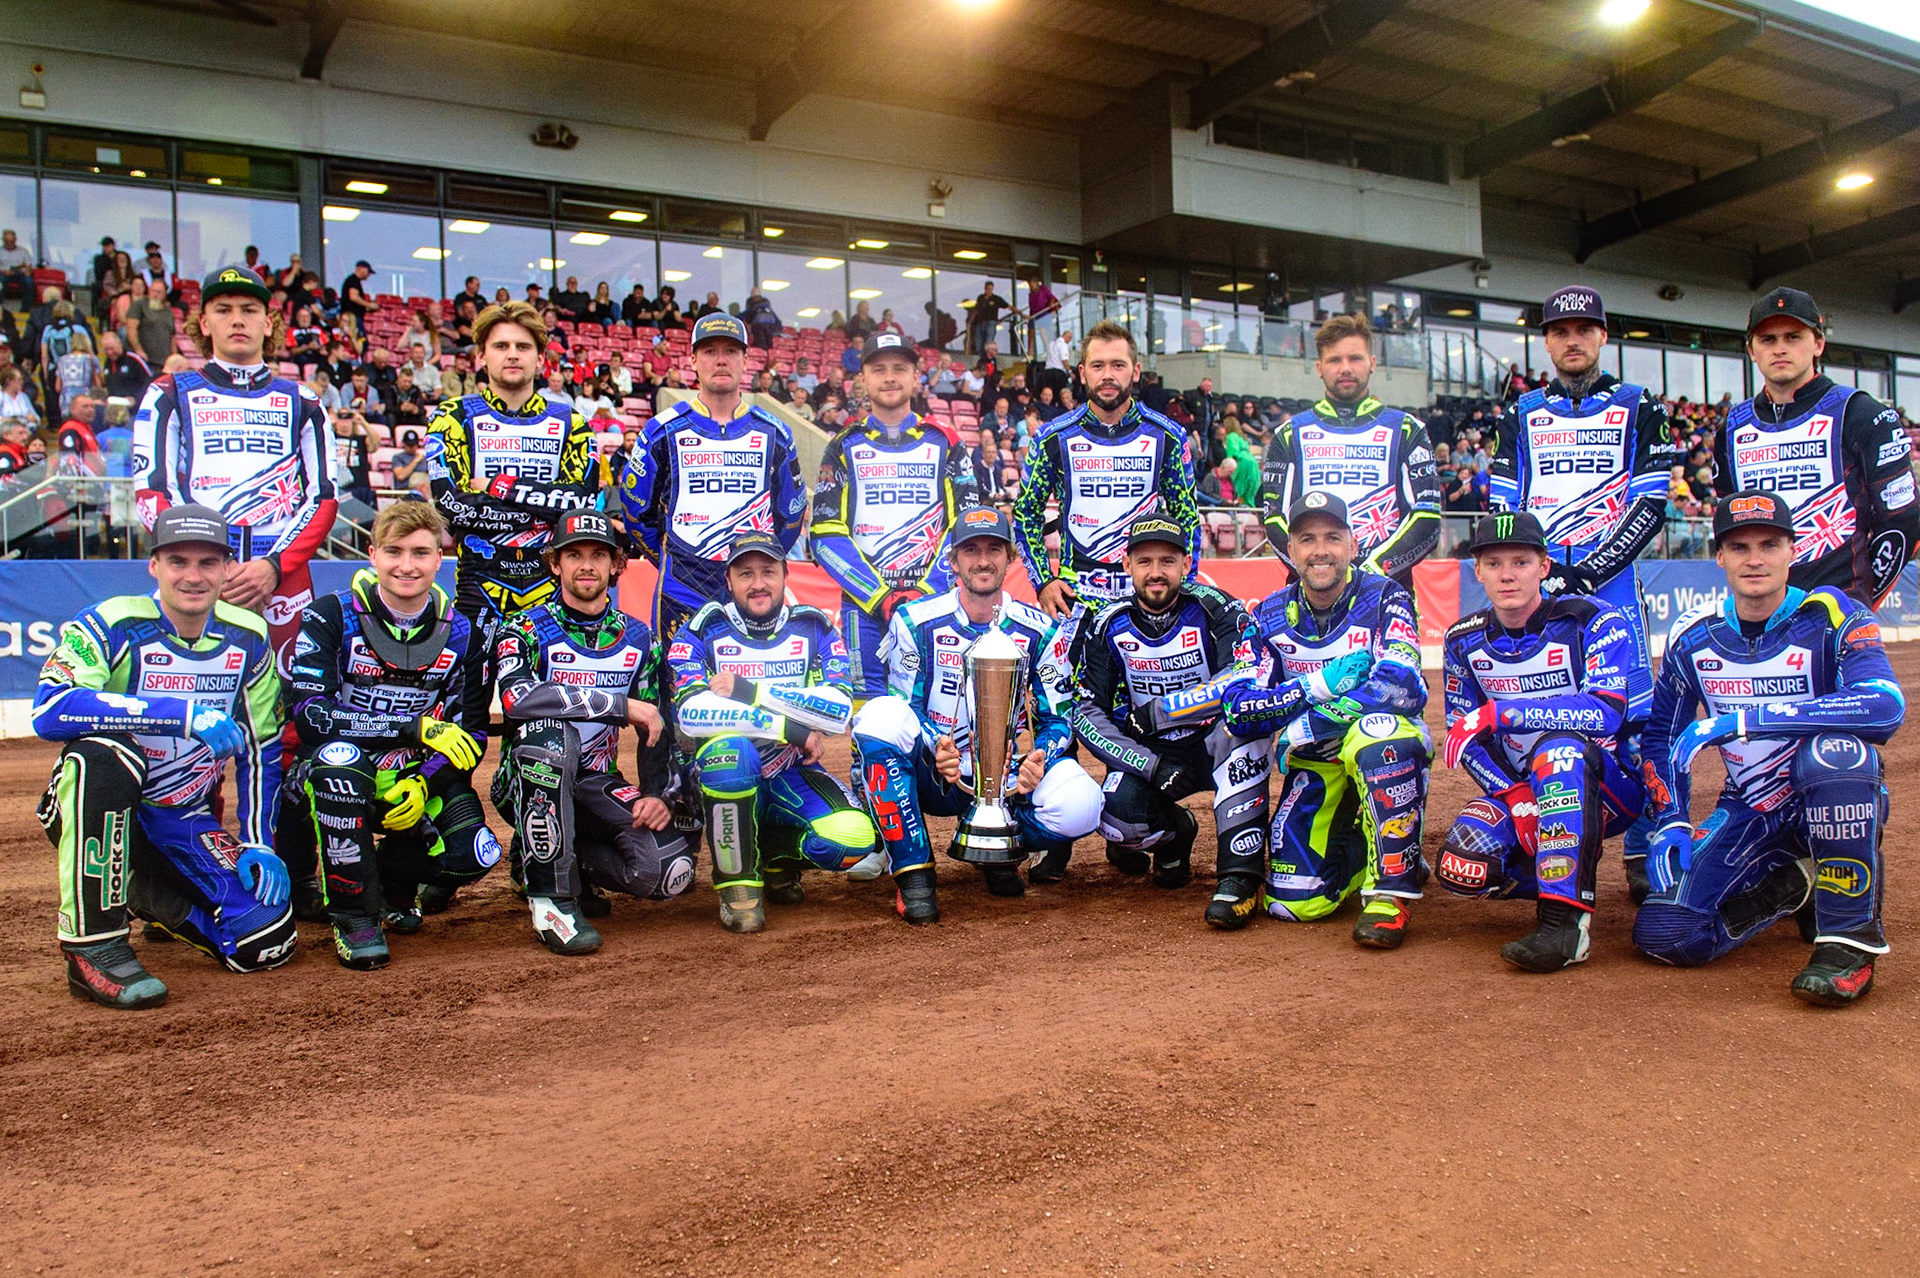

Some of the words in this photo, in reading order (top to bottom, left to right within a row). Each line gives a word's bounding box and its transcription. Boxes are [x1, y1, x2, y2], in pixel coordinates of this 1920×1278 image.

[1553, 293, 1593, 307] ADRIAN
[1559, 301, 1587, 312] FLUX
[270, 396, 288, 407] 18
[197, 410, 244, 424] SPORTS
[245, 411, 287, 426] INSURE
[1535, 417, 1549, 425] SCB
[1605, 411, 1625, 425] 10
[203, 429, 250, 438] BRITISH
[253, 430, 283, 438] FINAL
[547, 423, 560, 435] 2
[1808, 420, 1829, 437] 17
[749, 436, 763, 448] 5
[1372, 431, 1387, 442] 8
[1534, 431, 1575, 446] SPORTS
[1577, 430, 1620, 444] INSURE
[1741, 434, 1755, 443] SCB
[204, 438, 284, 455] 2022
[480, 438, 521, 450] SPORTS
[523, 439, 558, 453] INSURE
[1140, 440, 1150, 453] 7
[1305, 446, 1344, 458] SPORTS
[1346, 446, 1384, 458] INSURE
[684, 452, 723, 465] SPORTS
[724, 452, 762, 466] INSURE
[926, 448, 931, 460] 1
[1538, 450, 1580, 459] BRITISH
[1582, 450, 1615, 458] FINAL
[1739, 447, 1778, 465] SPORTS
[1779, 443, 1824, 459] INSURE
[859, 465, 897, 477] SPORTS
[898, 464, 934, 477] INSURE
[1074, 458, 1113, 470] SPORTS
[1114, 458, 1150, 470] INSURE
[1538, 459, 1614, 476] 2022
[1743, 466, 1784, 478] BRITISH
[1786, 464, 1821, 473] FINAL
[485, 465, 552, 481] 2022
[1309, 472, 1379, 486] 2022
[689, 479, 757, 494] 2022
[1744, 473, 1821, 491] 2022
[865, 490, 931, 505] 2022
[1080, 484, 1144, 498] 2022
[245, 500, 280, 523] BRITISH
[684, 513, 710, 521] BRITISH
[580, 514, 607, 532] FTS
[1567, 517, 1608, 542] BRITISH
[1819, 517, 1850, 538] FINAL
[1586, 506, 1654, 571] HINCHLIFFE
[895, 541, 930, 568] BRITISH
[500, 560, 540, 569] SIMPSONS
[1674, 586, 1728, 615] World
[940, 636, 956, 645] SCB
[1181, 630, 1198, 649] 13
[1348, 631, 1368, 650] 14
[789, 641, 803, 655] 3
[150, 655, 168, 664] SCB
[225, 652, 243, 670] 12
[556, 653, 571, 662] SCB
[623, 652, 638, 667] 9
[1162, 651, 1201, 670] INSURE
[1477, 661, 1490, 669] SCB
[1547, 648, 1564, 667] 6
[1702, 660, 1718, 669] SCB
[1786, 653, 1804, 671] 4
[721, 663, 764, 676] SPORTS
[766, 662, 803, 676] INSURE
[1284, 659, 1321, 673] SPORTS
[147, 674, 195, 691] SPORTS
[197, 674, 237, 691] INSURE
[553, 670, 596, 685] SPORTS
[597, 671, 632, 687] INSURE
[1129, 674, 1169, 682] BRITISH
[1170, 670, 1201, 681] FINAL
[1482, 677, 1520, 692] SPORTS
[1521, 671, 1567, 690] INSURE
[353, 685, 402, 697] BRITISH
[1704, 679, 1751, 695] SPORTS
[1753, 677, 1806, 694] INSURE
[349, 689, 426, 713] 2022
[1240, 689, 1301, 713] STELLAR
[1713, 701, 1761, 711] BRITISH
[59, 714, 100, 723] Grant
[103, 715, 181, 726] Henderson
[1365, 713, 1392, 725] ATPI
[1525, 708, 1604, 721] KRAJEWSKI
[351, 721, 389, 730] Tankers
[1525, 720, 1605, 731] KONSTRUKCJE
[1080, 720, 1122, 757] Warren
[1122, 748, 1148, 771] Ltd
[1821, 739, 1858, 755] ATPI
[724, 755, 738, 763] OIL
[523, 769, 542, 780] ROCK
[543, 775, 558, 785] OIL
[1472, 759, 1510, 788] Henderson
[886, 757, 919, 838] FILTRATION
[1540, 799, 1561, 810] ROCK
[1562, 796, 1579, 807] OIL
[1834, 803, 1874, 822] DOOR
[114, 813, 125, 845] OIL
[719, 807, 734, 850] SPRINT
[1809, 821, 1867, 840] PROJECT
[1441, 853, 1485, 878] AMD
[110, 849, 123, 904] ROCK
[1443, 871, 1481, 885] GROUP
